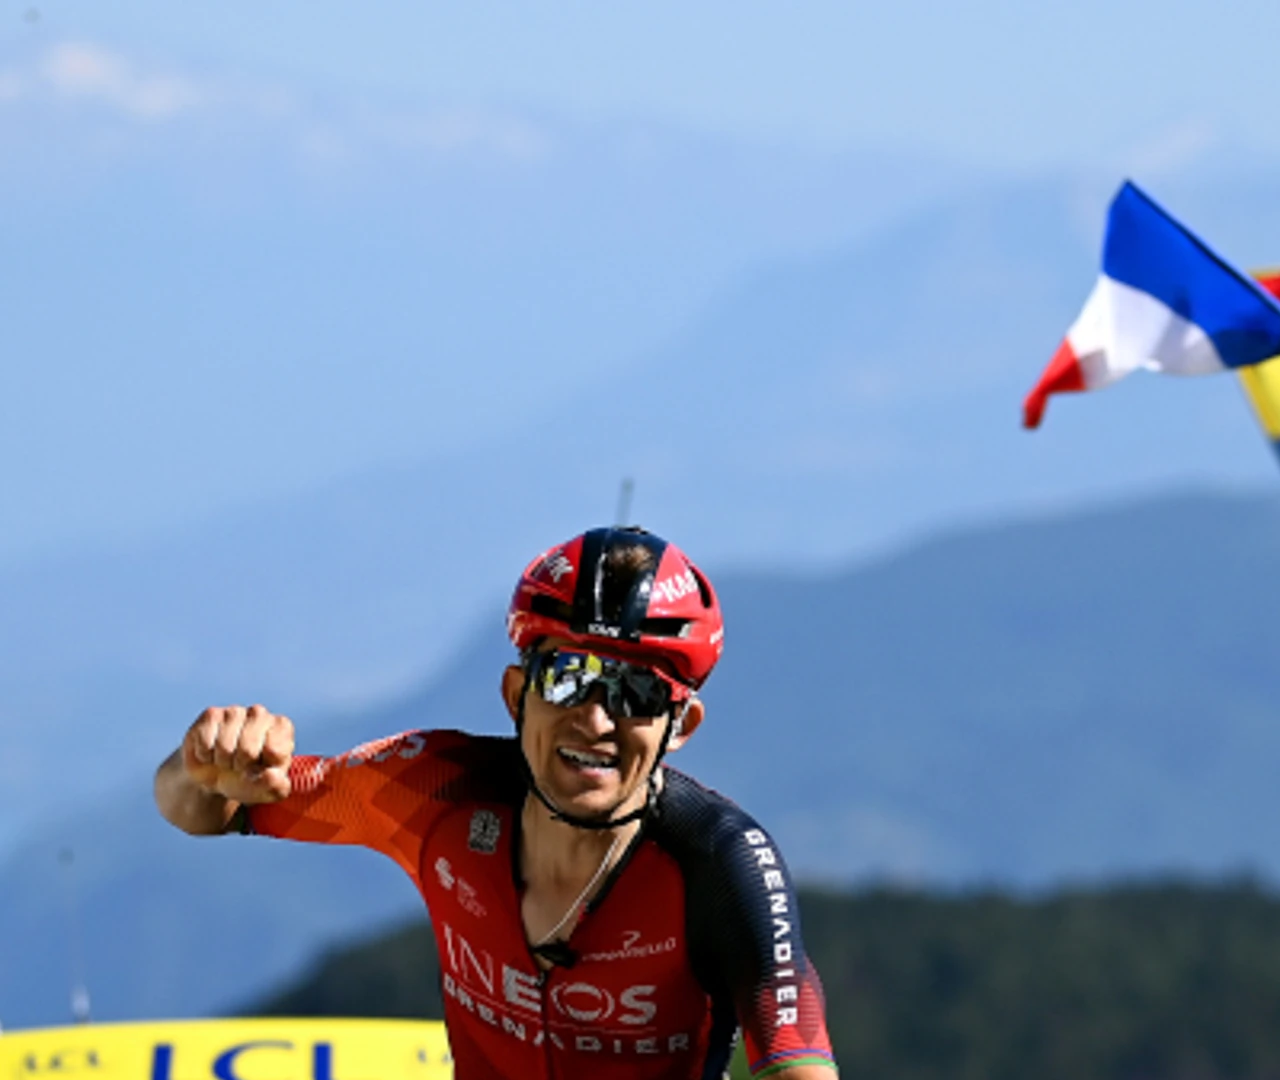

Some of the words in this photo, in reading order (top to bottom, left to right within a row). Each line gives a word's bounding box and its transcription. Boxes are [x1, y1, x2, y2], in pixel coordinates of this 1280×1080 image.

[442, 921, 658, 1026] INEOS
[743, 827, 799, 1027] GRENADIER
[443, 971, 689, 1055] GRENADIER
